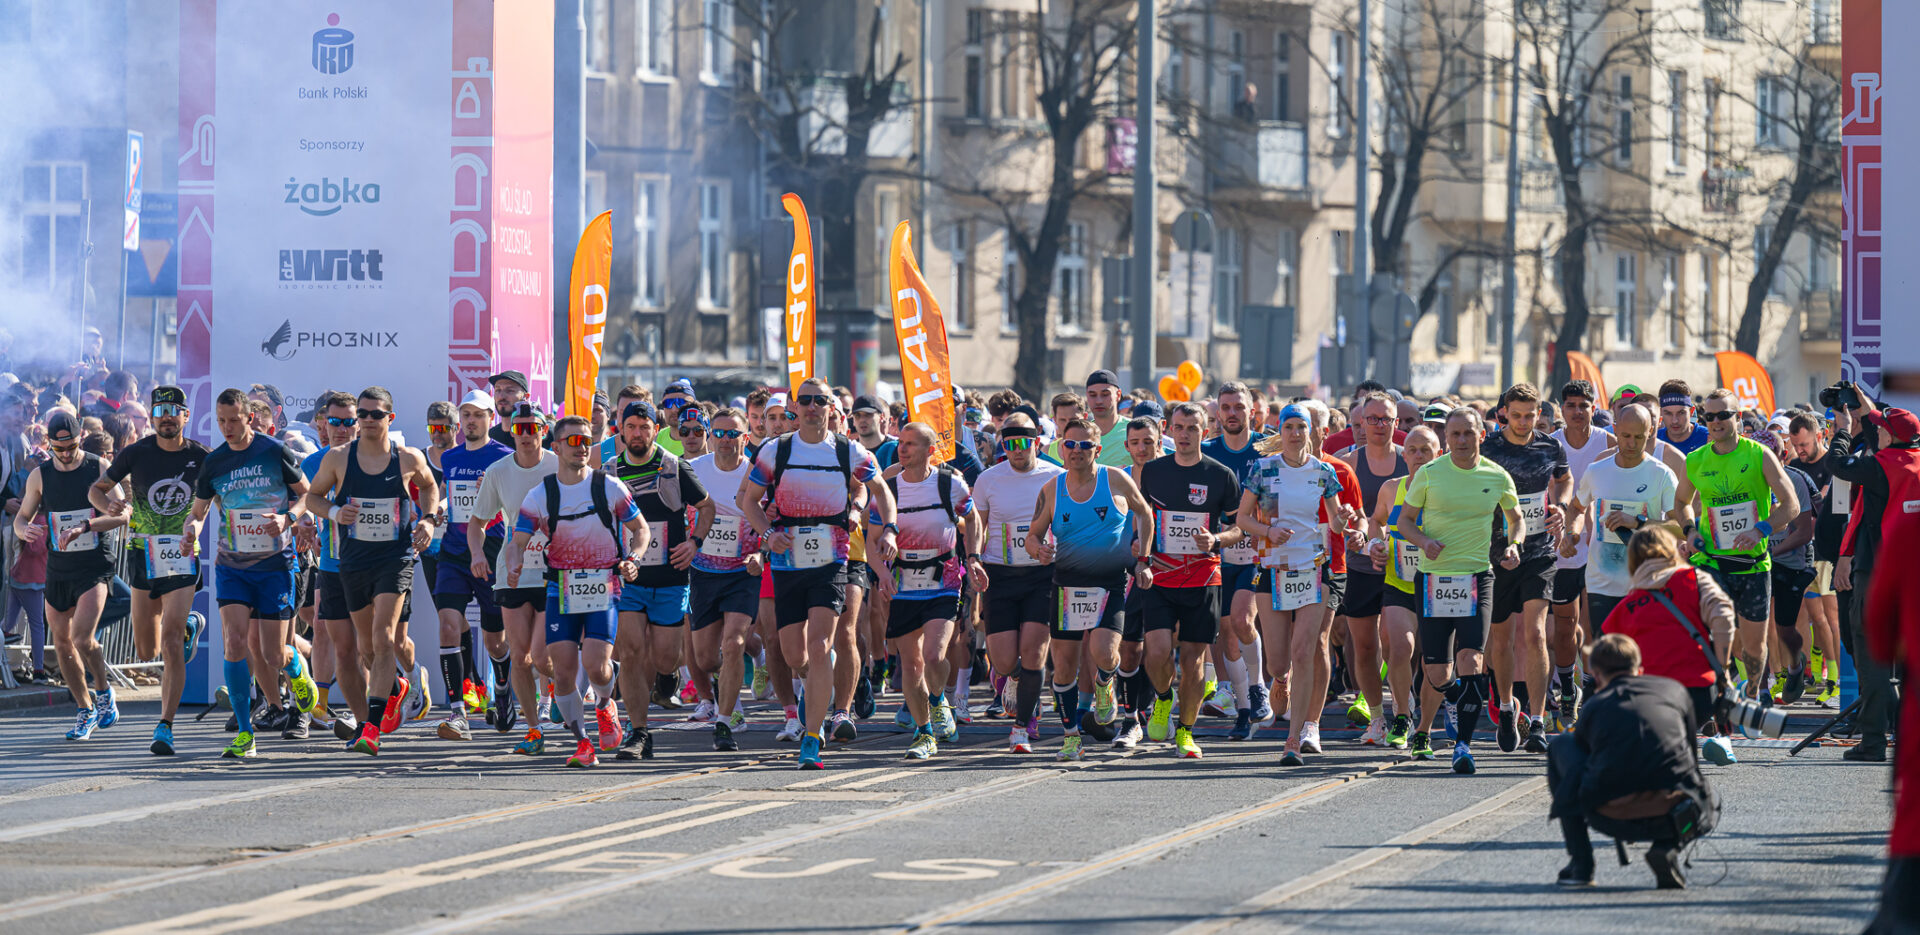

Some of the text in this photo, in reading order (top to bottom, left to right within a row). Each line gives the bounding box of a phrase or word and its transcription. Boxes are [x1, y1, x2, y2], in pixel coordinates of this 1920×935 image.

[299, 87, 368, 99] Bank Polski
[300, 139, 365, 152] Sponsorzy
[284, 177, 380, 203] żabka
[292, 249, 383, 281] Witt
[897, 287, 945, 414] 1:40
[453, 495, 477, 507] 1101
[1711, 492, 1750, 506] FINISHER
[359, 513, 390, 525] 2858
[1721, 518, 1748, 532] 5167
[1168, 526, 1200, 538] 3250
[804, 539, 819, 550] 63
[160, 549, 182, 560] 666
[568, 583, 607, 596] 13260
[1284, 580, 1312, 594] 8106
[1435, 588, 1468, 600] 8454
[1071, 602, 1098, 614] 11743
